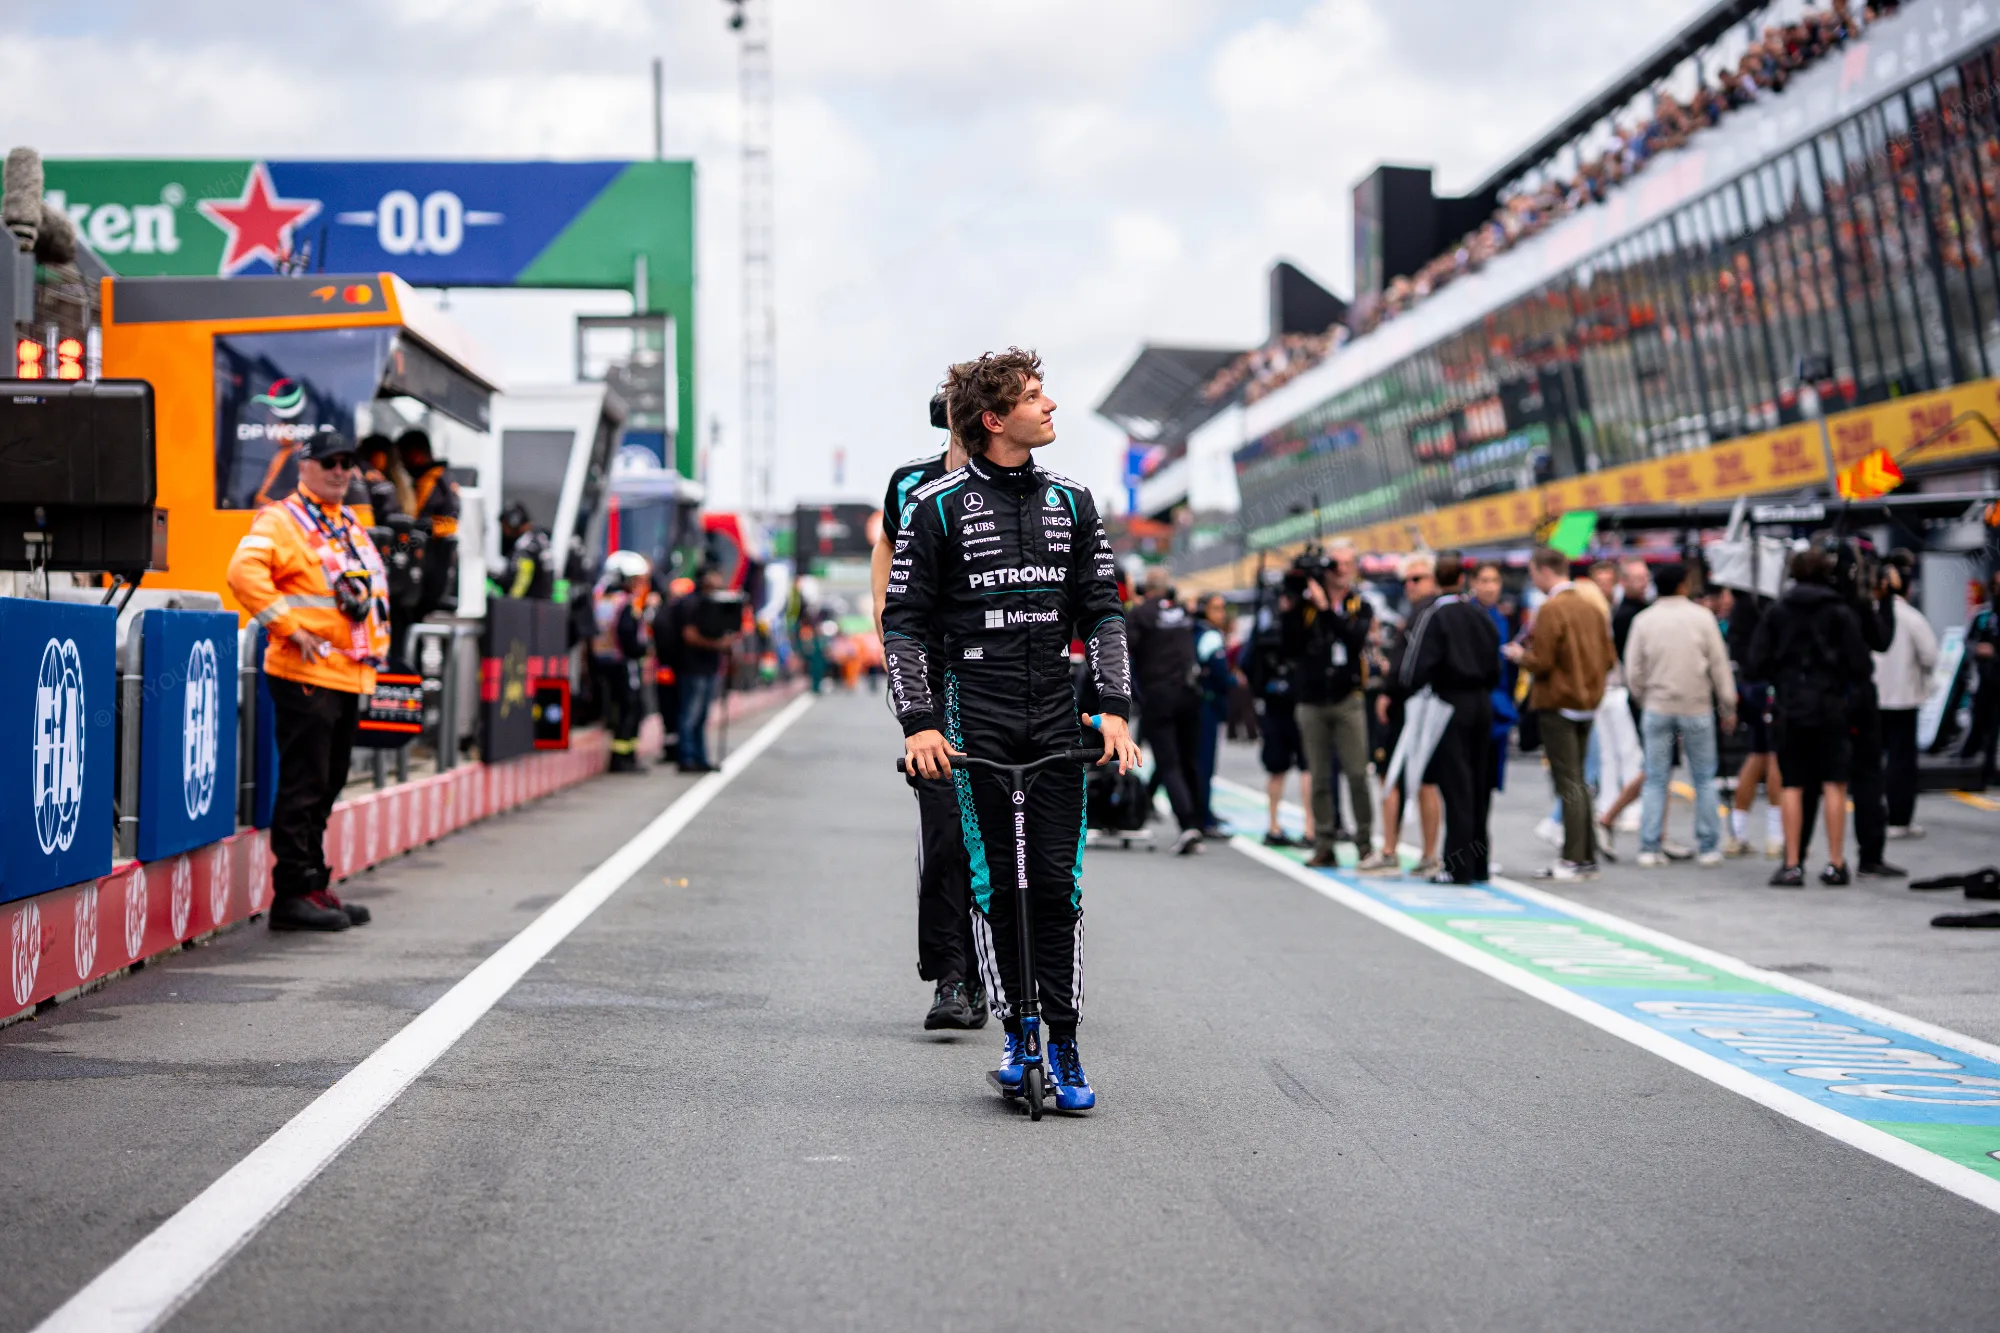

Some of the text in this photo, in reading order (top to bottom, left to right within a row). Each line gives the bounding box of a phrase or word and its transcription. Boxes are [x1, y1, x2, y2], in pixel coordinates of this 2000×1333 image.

[974, 521, 996, 532] UBS
[1042, 516, 1072, 527] INEOS
[972, 548, 1003, 558] Snapdragon
[1048, 543, 1071, 553] HPE
[968, 566, 1068, 589] PETRONAS
[1007, 609, 1059, 624] Microsoft
[963, 648, 984, 659] OMP
[891, 667, 905, 700] Meta
[1014, 812, 1028, 889] Kimi Antonelli
